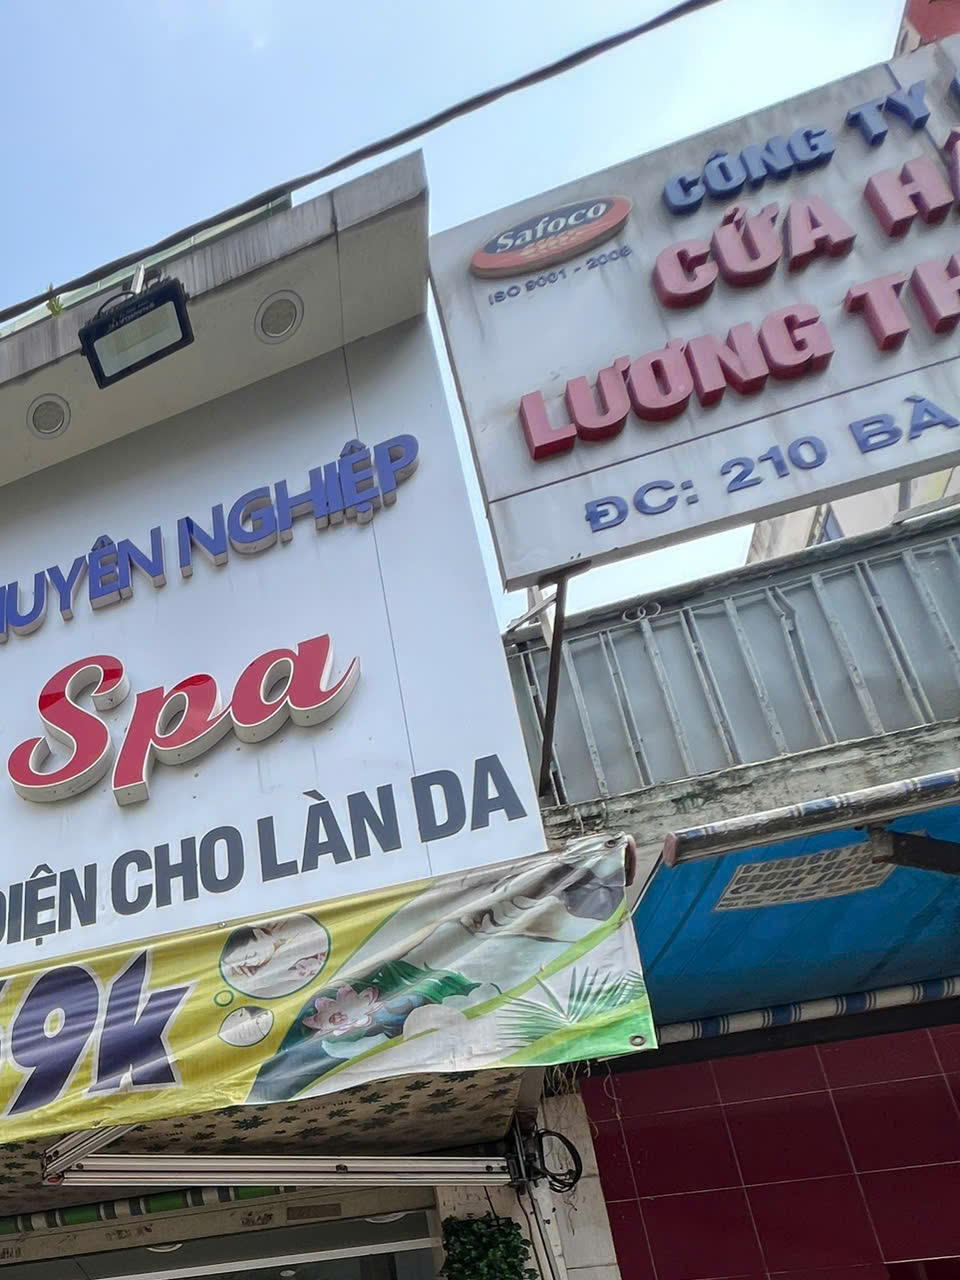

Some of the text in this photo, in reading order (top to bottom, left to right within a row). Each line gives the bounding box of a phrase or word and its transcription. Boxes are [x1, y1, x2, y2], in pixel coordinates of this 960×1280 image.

[662, 126, 837, 216] CÔNG
[845, 79, 931, 147] TY
[488, 285, 521, 305] ISO
[525, 268, 567, 292] 9001
[495, 203, 607, 253] Safoco
[653, 130, 960, 310] CỬA H
[518, 302, 835, 462] LƯƠNG
[177, 434, 420, 576] NGHIỆP
[585, 393, 960, 533] ĐC: 210 BÀ
[7, 633, 361, 808] Spa
[110, 824, 245, 917] CHO
[257, 784, 401, 884] LÀN
[410, 753, 528, 845] DA
